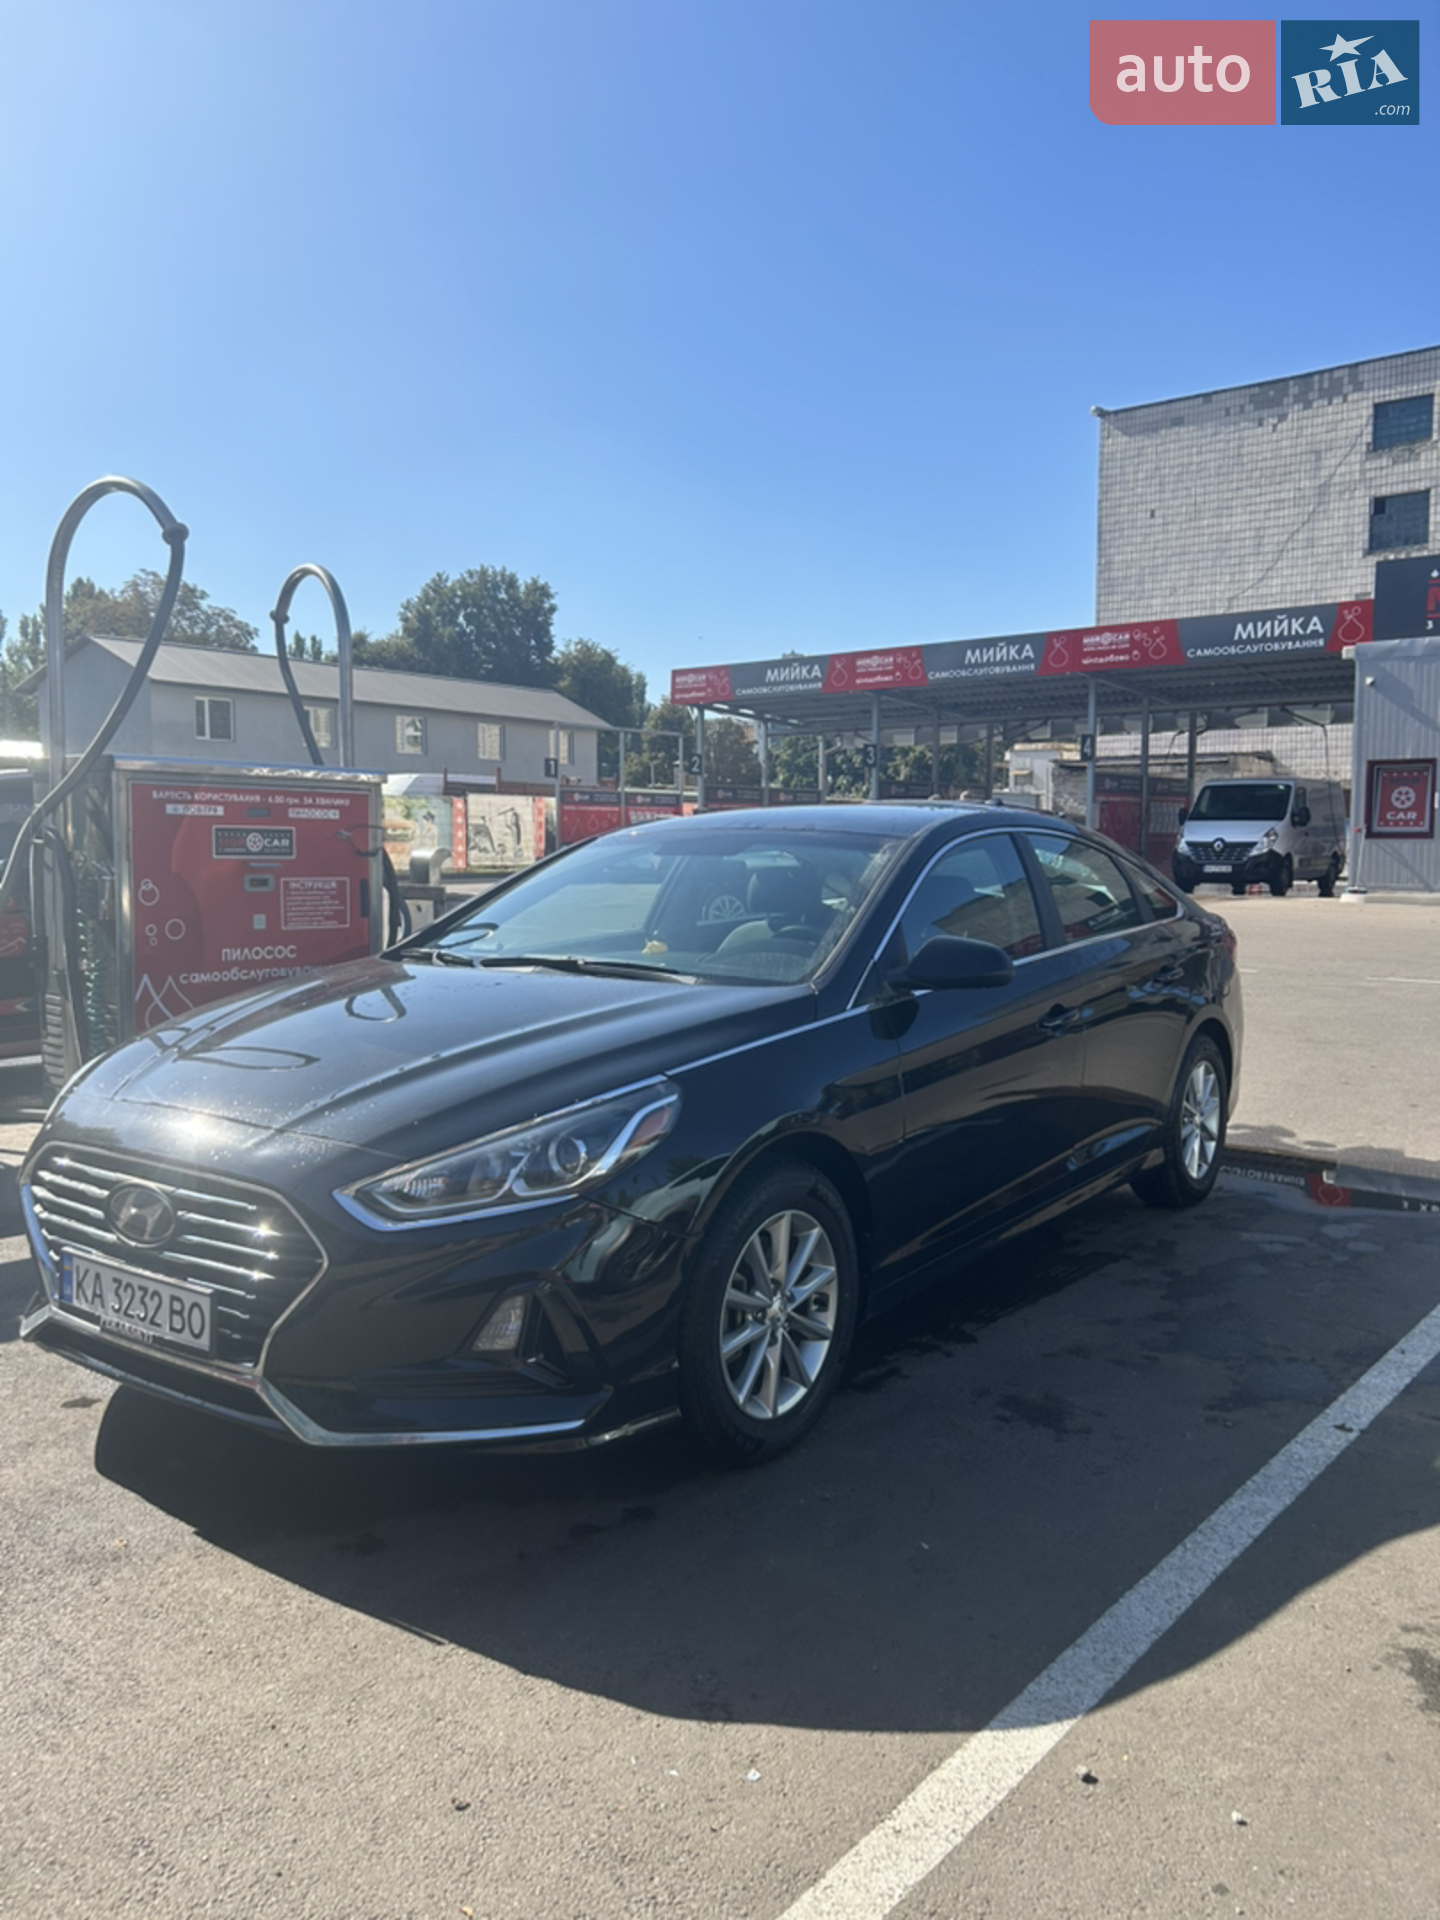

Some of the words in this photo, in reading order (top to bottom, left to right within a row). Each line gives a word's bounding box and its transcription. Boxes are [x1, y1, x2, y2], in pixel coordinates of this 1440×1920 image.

[1233, 614, 1325, 641] МИЙКА
[964, 642, 1035, 666] МИЙКА
[1187, 638, 1325, 659] САМООБСЛУГОВУВАННЯ
[765, 662, 823, 684] МИЙКА
[927, 662, 1036, 681] САМООБСЛУГОВУВАННЯ
[690, 755, 700, 773] 2
[866, 745, 876, 765] 3
[549, 759, 556, 776] 1
[1386, 811, 1418, 820] CAR
[264, 838, 291, 848] CAR
[221, 945, 297, 962] ПИЛОСОС
[179, 965, 332, 984] самообслуговува
[74, 1264, 106, 1310] KA
[111, 1276, 163, 1329] 3232
[168, 1294, 206, 1341] BO
